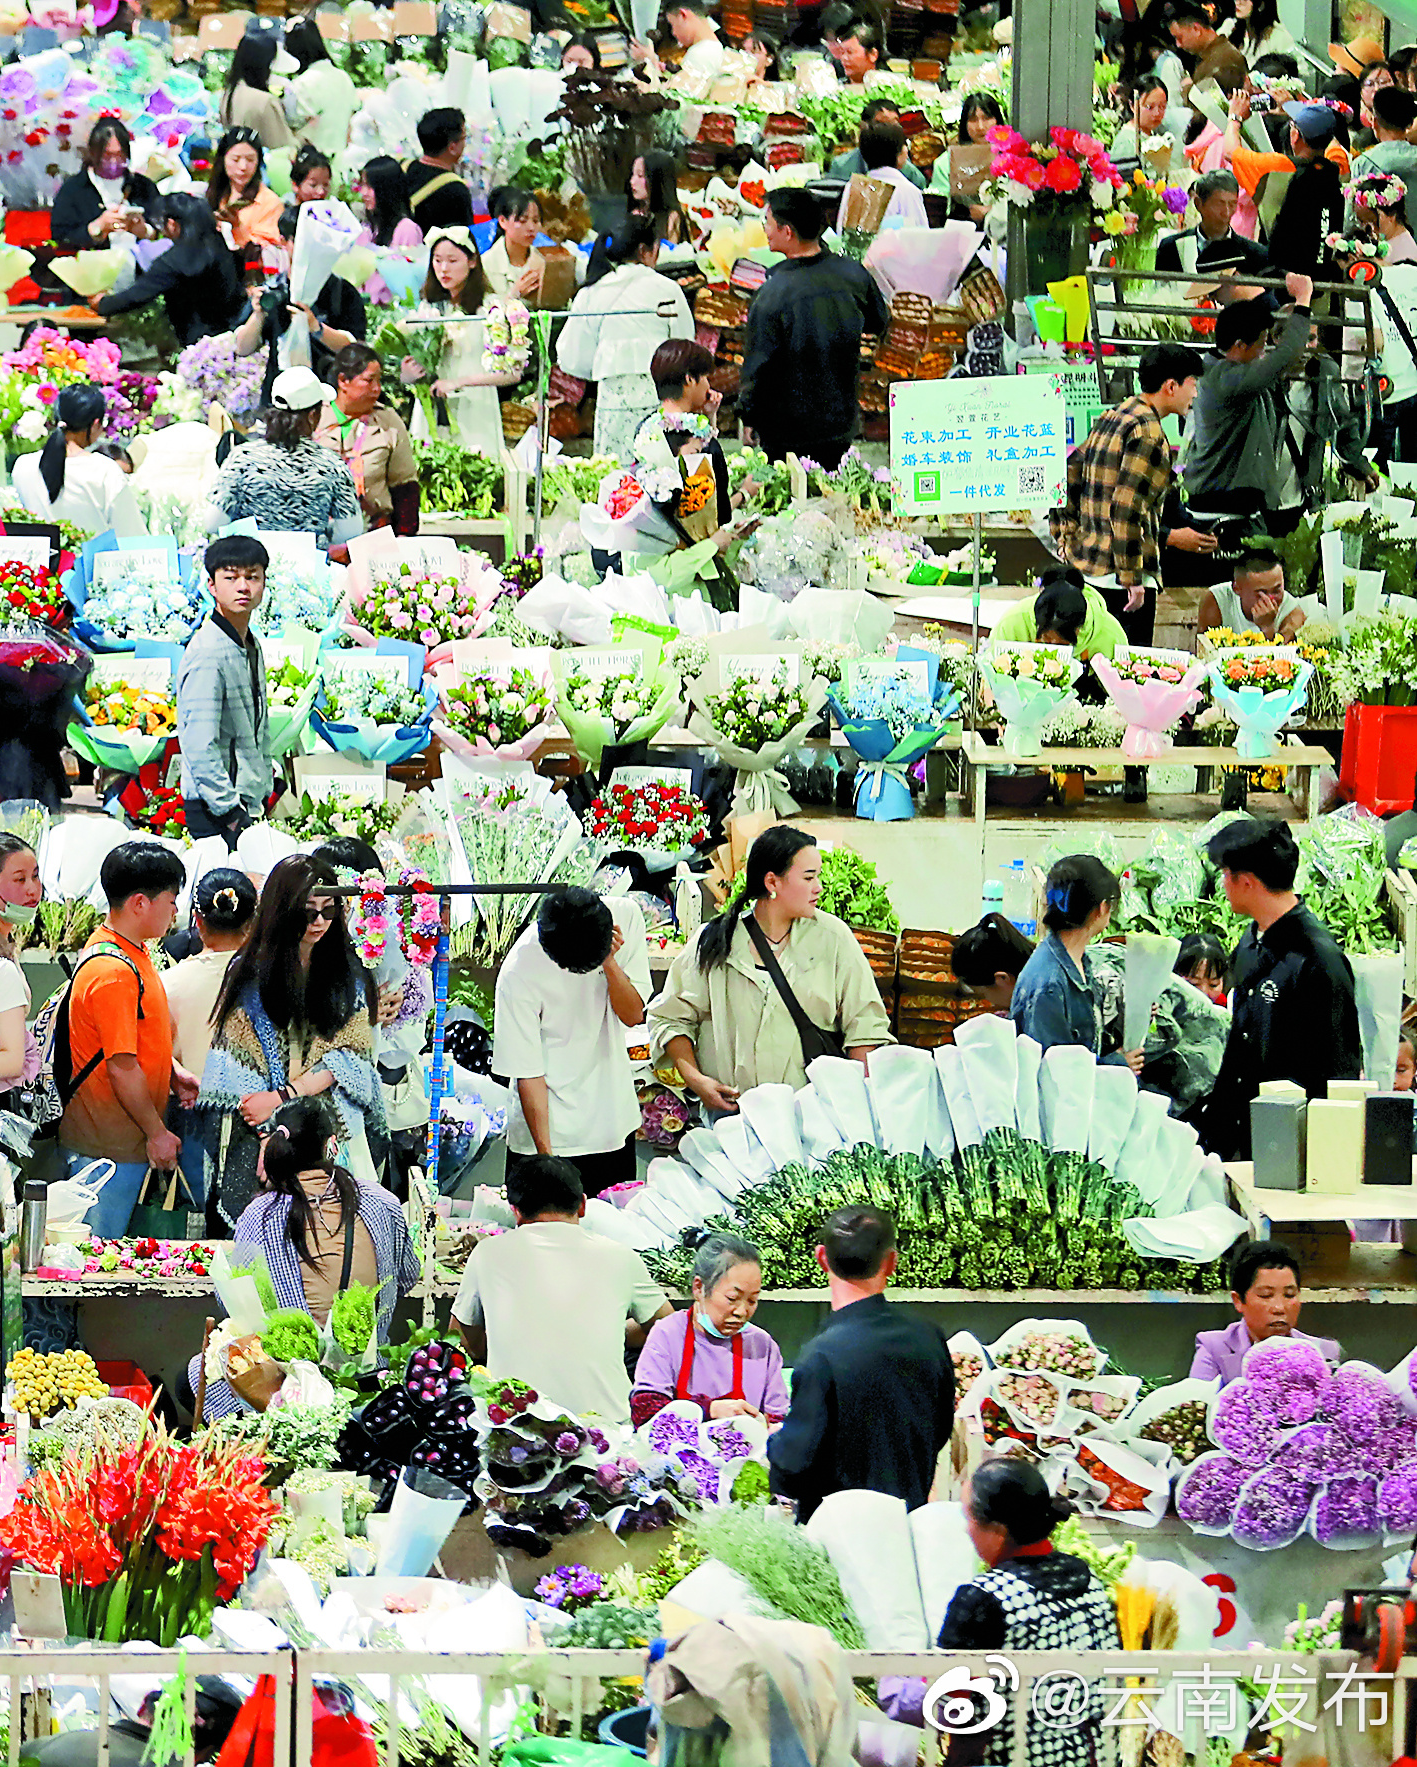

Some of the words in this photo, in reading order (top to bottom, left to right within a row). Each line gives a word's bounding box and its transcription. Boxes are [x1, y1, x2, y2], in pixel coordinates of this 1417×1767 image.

[901, 429, 972, 445] 花束加工
[901, 450, 973, 466] 婚车装饰
[986, 446, 1056, 461] 礼盒加工
[949, 483, 1007, 498] 一件代发
